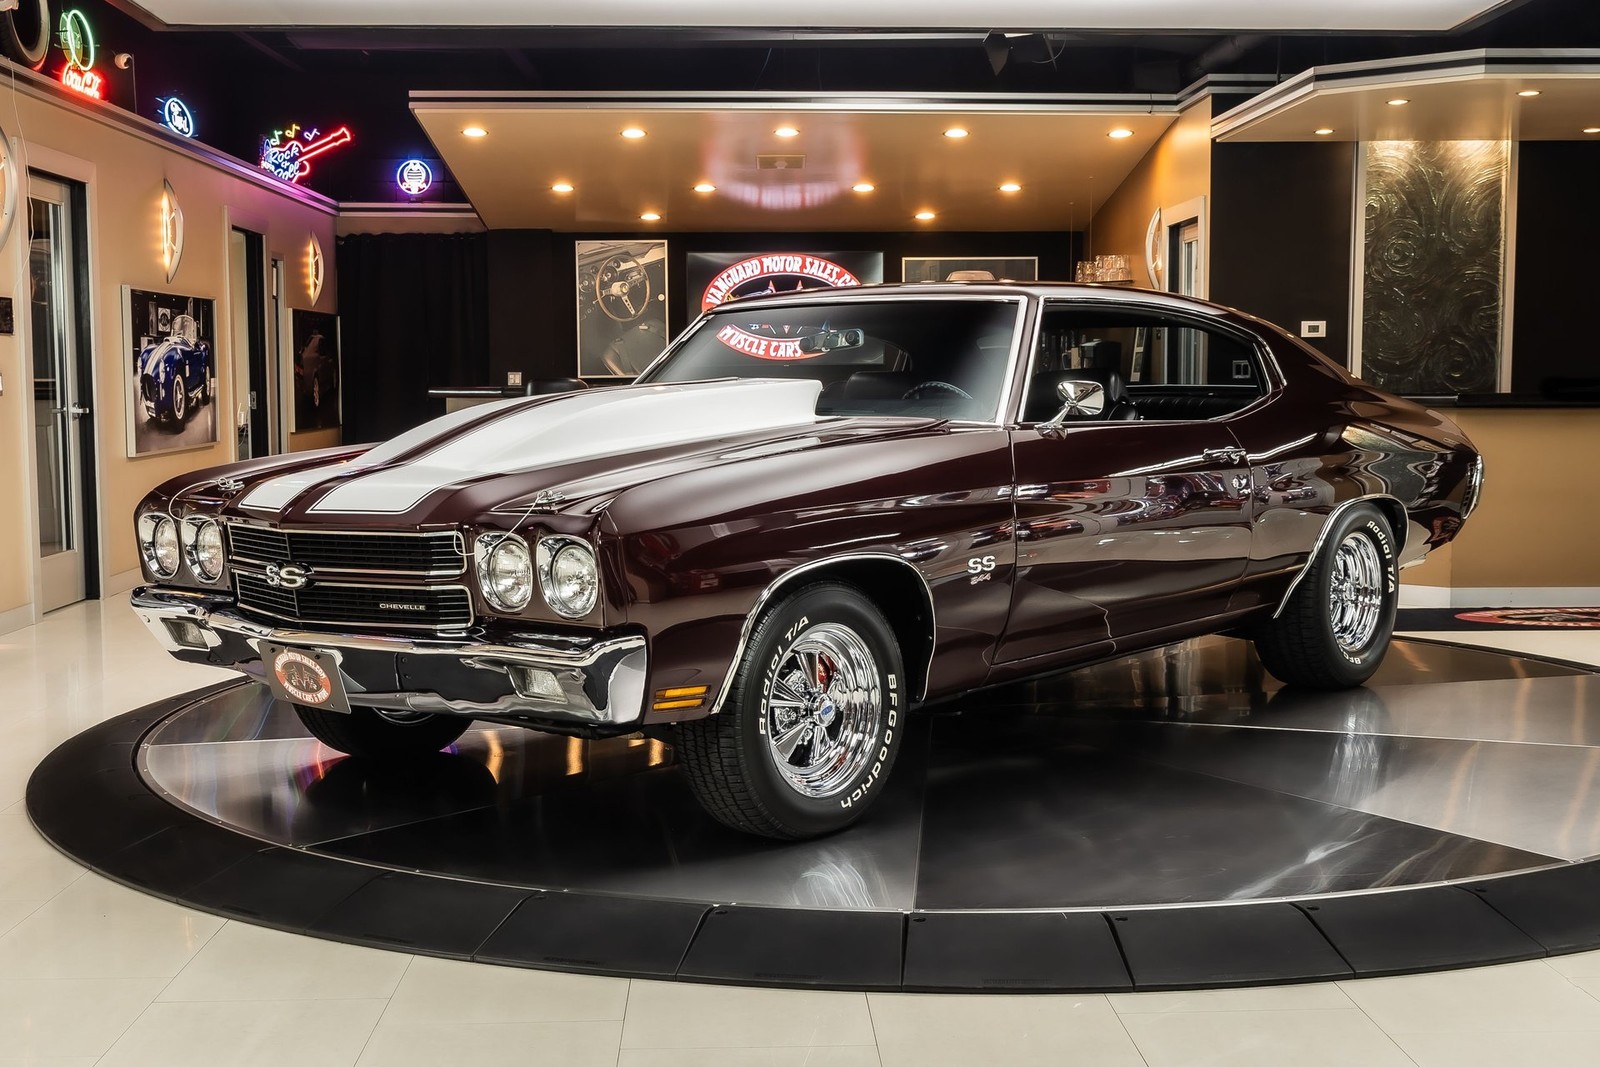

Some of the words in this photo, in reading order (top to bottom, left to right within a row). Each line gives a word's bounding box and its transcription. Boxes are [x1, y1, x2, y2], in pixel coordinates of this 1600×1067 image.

[266, 143, 300, 164] Rock
[705, 259, 761, 305] VANGUARD
[761, 255, 803, 273] MOTOR
[720, 325, 768, 355] MUSCLE
[769, 340, 803, 357] CARS
[967, 555, 995, 573] SS
[1366, 520, 1392, 559] Radial
[1387, 564, 1395, 593] T/A
[266, 565, 306, 588] SS
[379, 603, 426, 611] CHEVELLE
[759, 646, 783, 734] Radial
[785, 616, 809, 641] T/A
[841, 673, 898, 809] BFGoodrich
